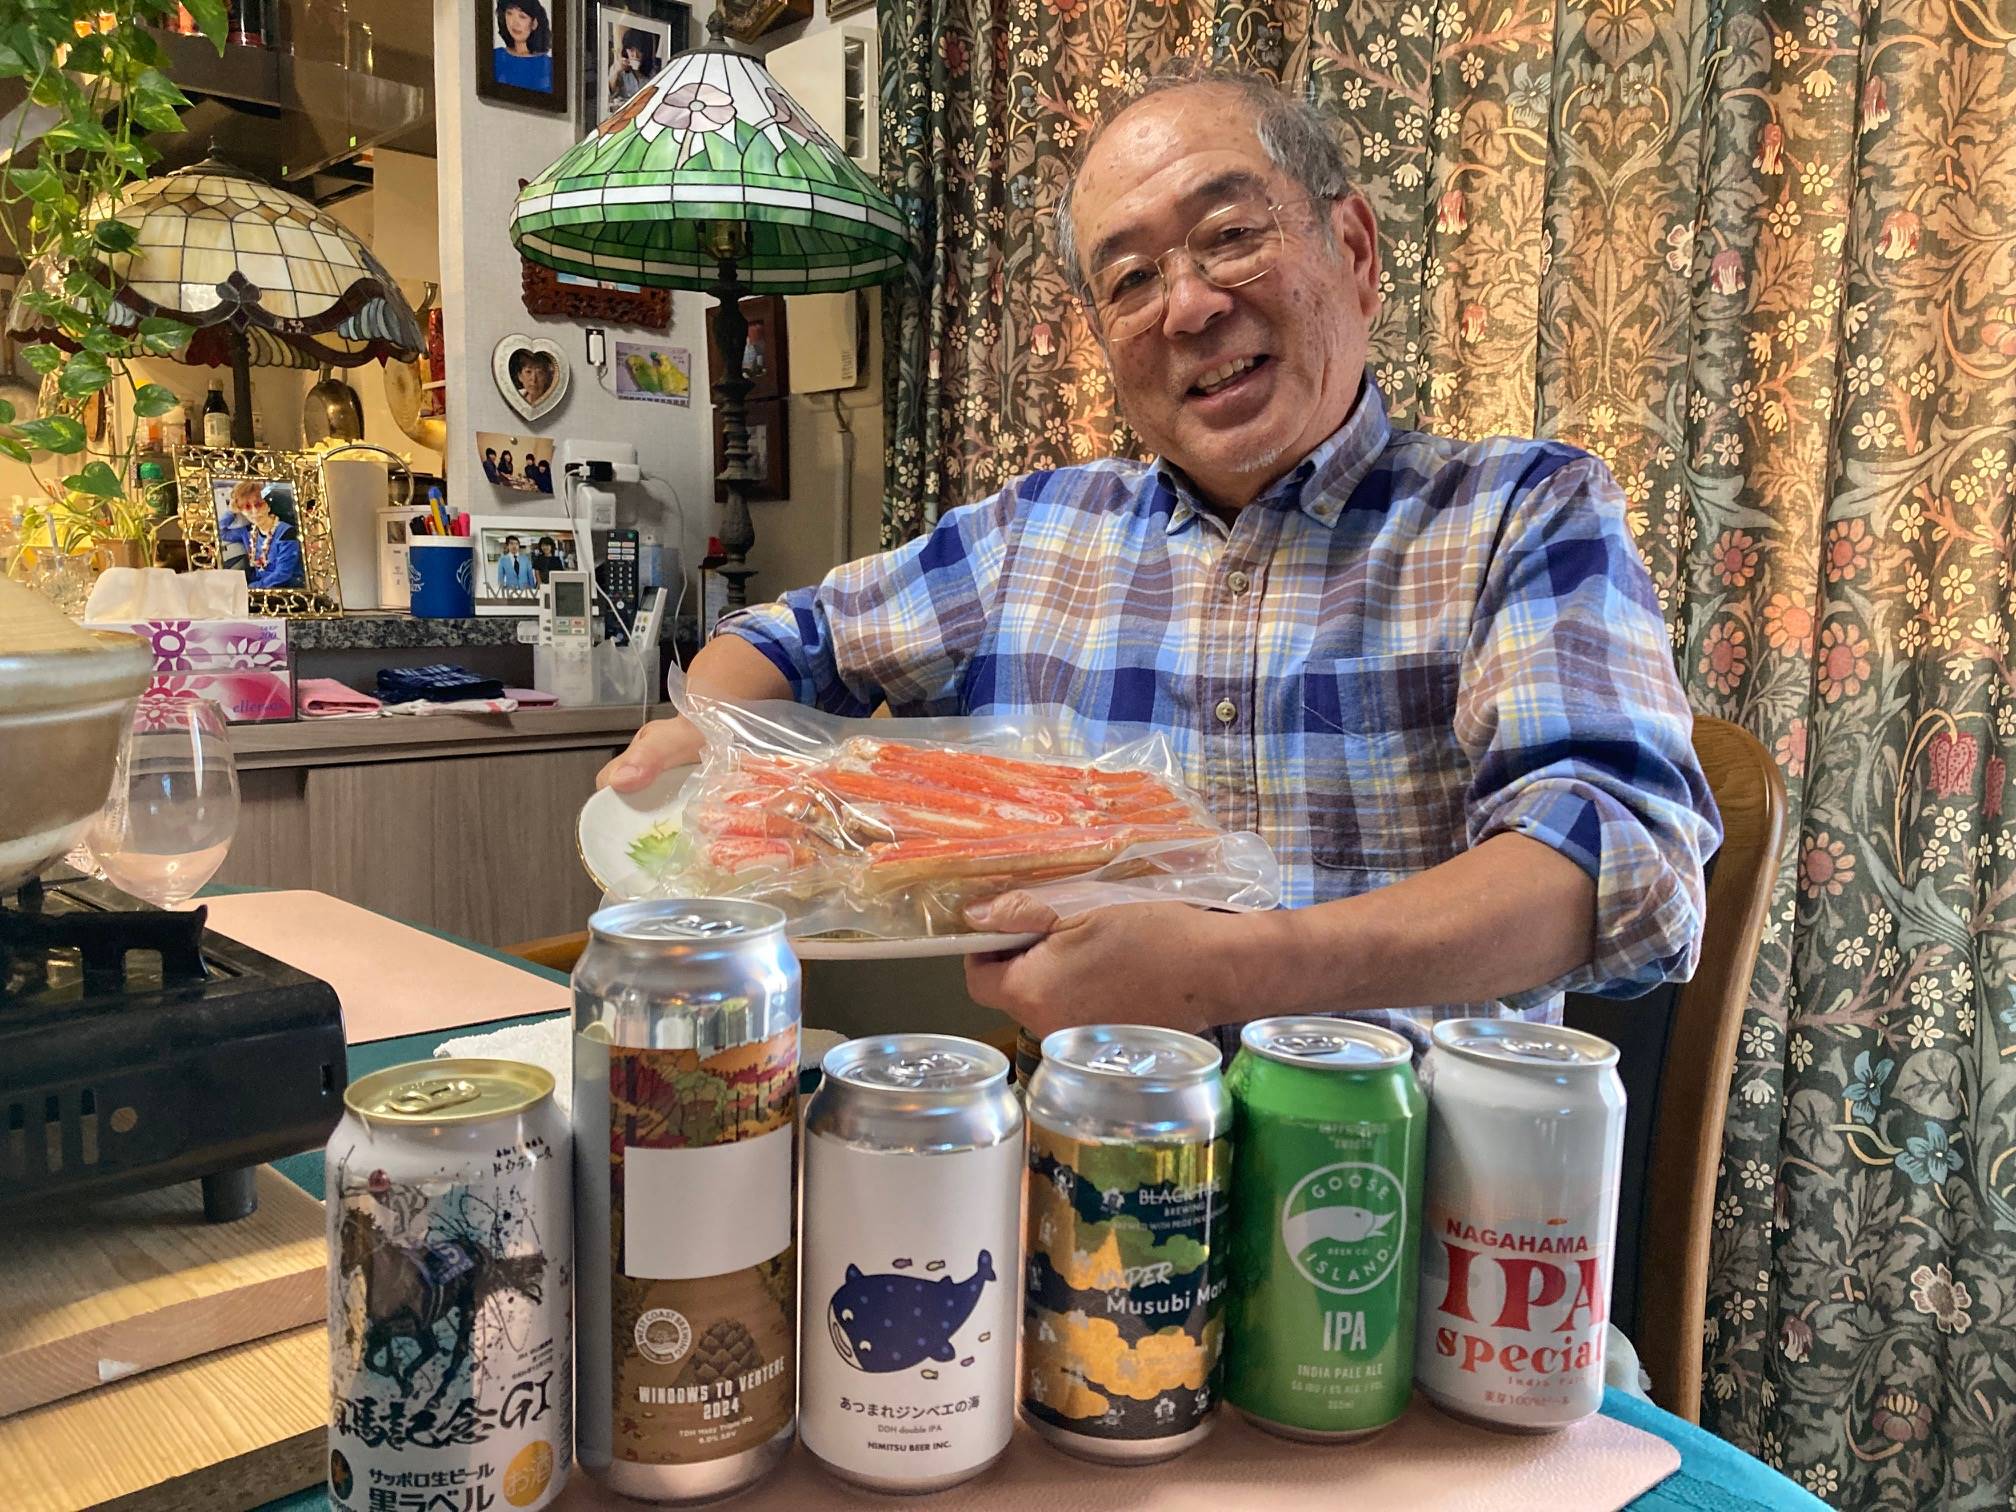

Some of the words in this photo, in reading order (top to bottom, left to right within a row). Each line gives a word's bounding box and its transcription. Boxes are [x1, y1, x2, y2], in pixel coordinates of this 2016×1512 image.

[1139, 1186, 1195, 1205] BLACK
[1311, 1175, 1389, 1200] GOOSE
[1446, 1218, 1588, 1253] NAGAHAMA
[1306, 1248, 1389, 1282] ISLAND
[1438, 1240, 1605, 1333] IPA
[1107, 1290, 1190, 1315] Musubi
[1323, 1311, 1367, 1351] IPA
[1298, 1365, 1330, 1378] INDIA
[1334, 1367, 1361, 1378] PALE
[1366, 1363, 1383, 1376] ALE
[638, 1385, 708, 1404] WINDOWS
[716, 1380, 733, 1398] TO
[704, 1397, 739, 1420] 2024
[909, 1443, 930, 1451] BEER
[368, 1463, 495, 1487] サッポロ生ビール
